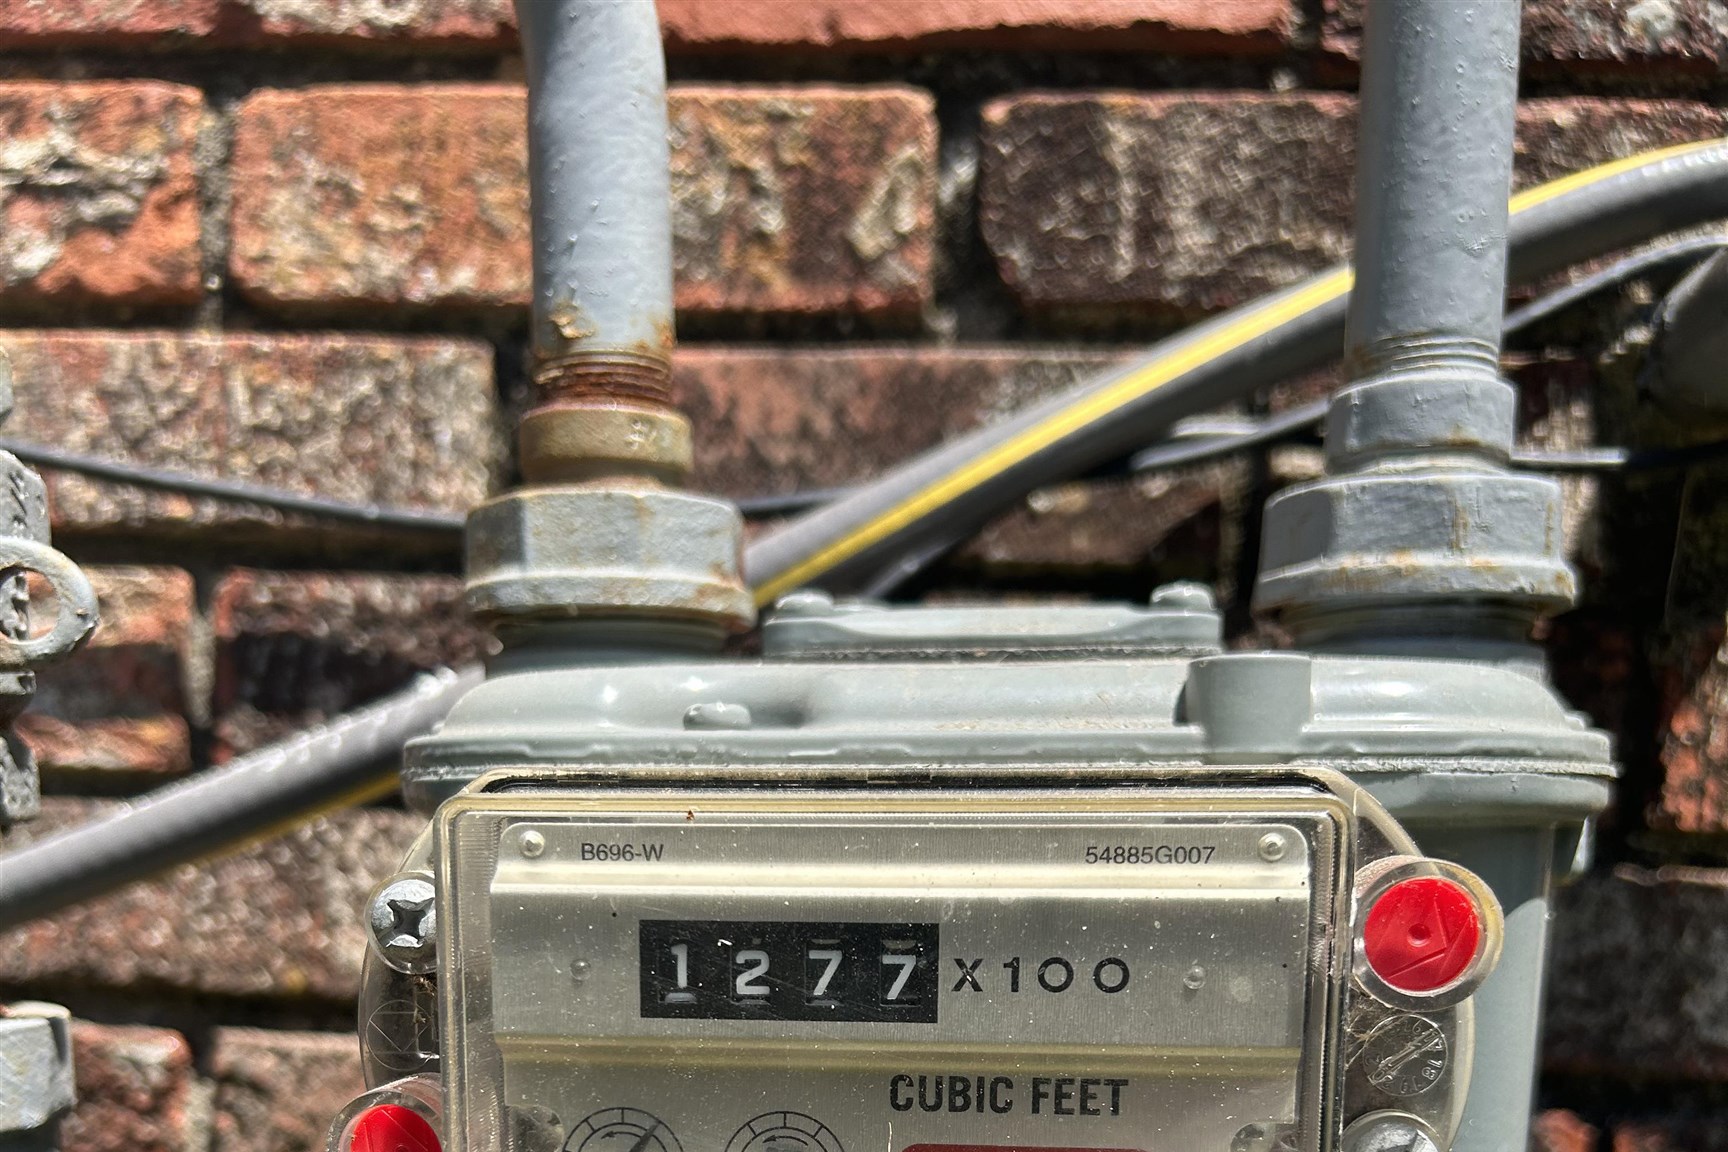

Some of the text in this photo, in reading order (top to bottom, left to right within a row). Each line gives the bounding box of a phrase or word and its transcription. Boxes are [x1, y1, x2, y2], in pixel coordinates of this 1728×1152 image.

[581, 841, 664, 862] B696-W
[1085, 845, 1215, 865] 54885G007
[890, 1074, 1128, 1116] CUBIC FEET
